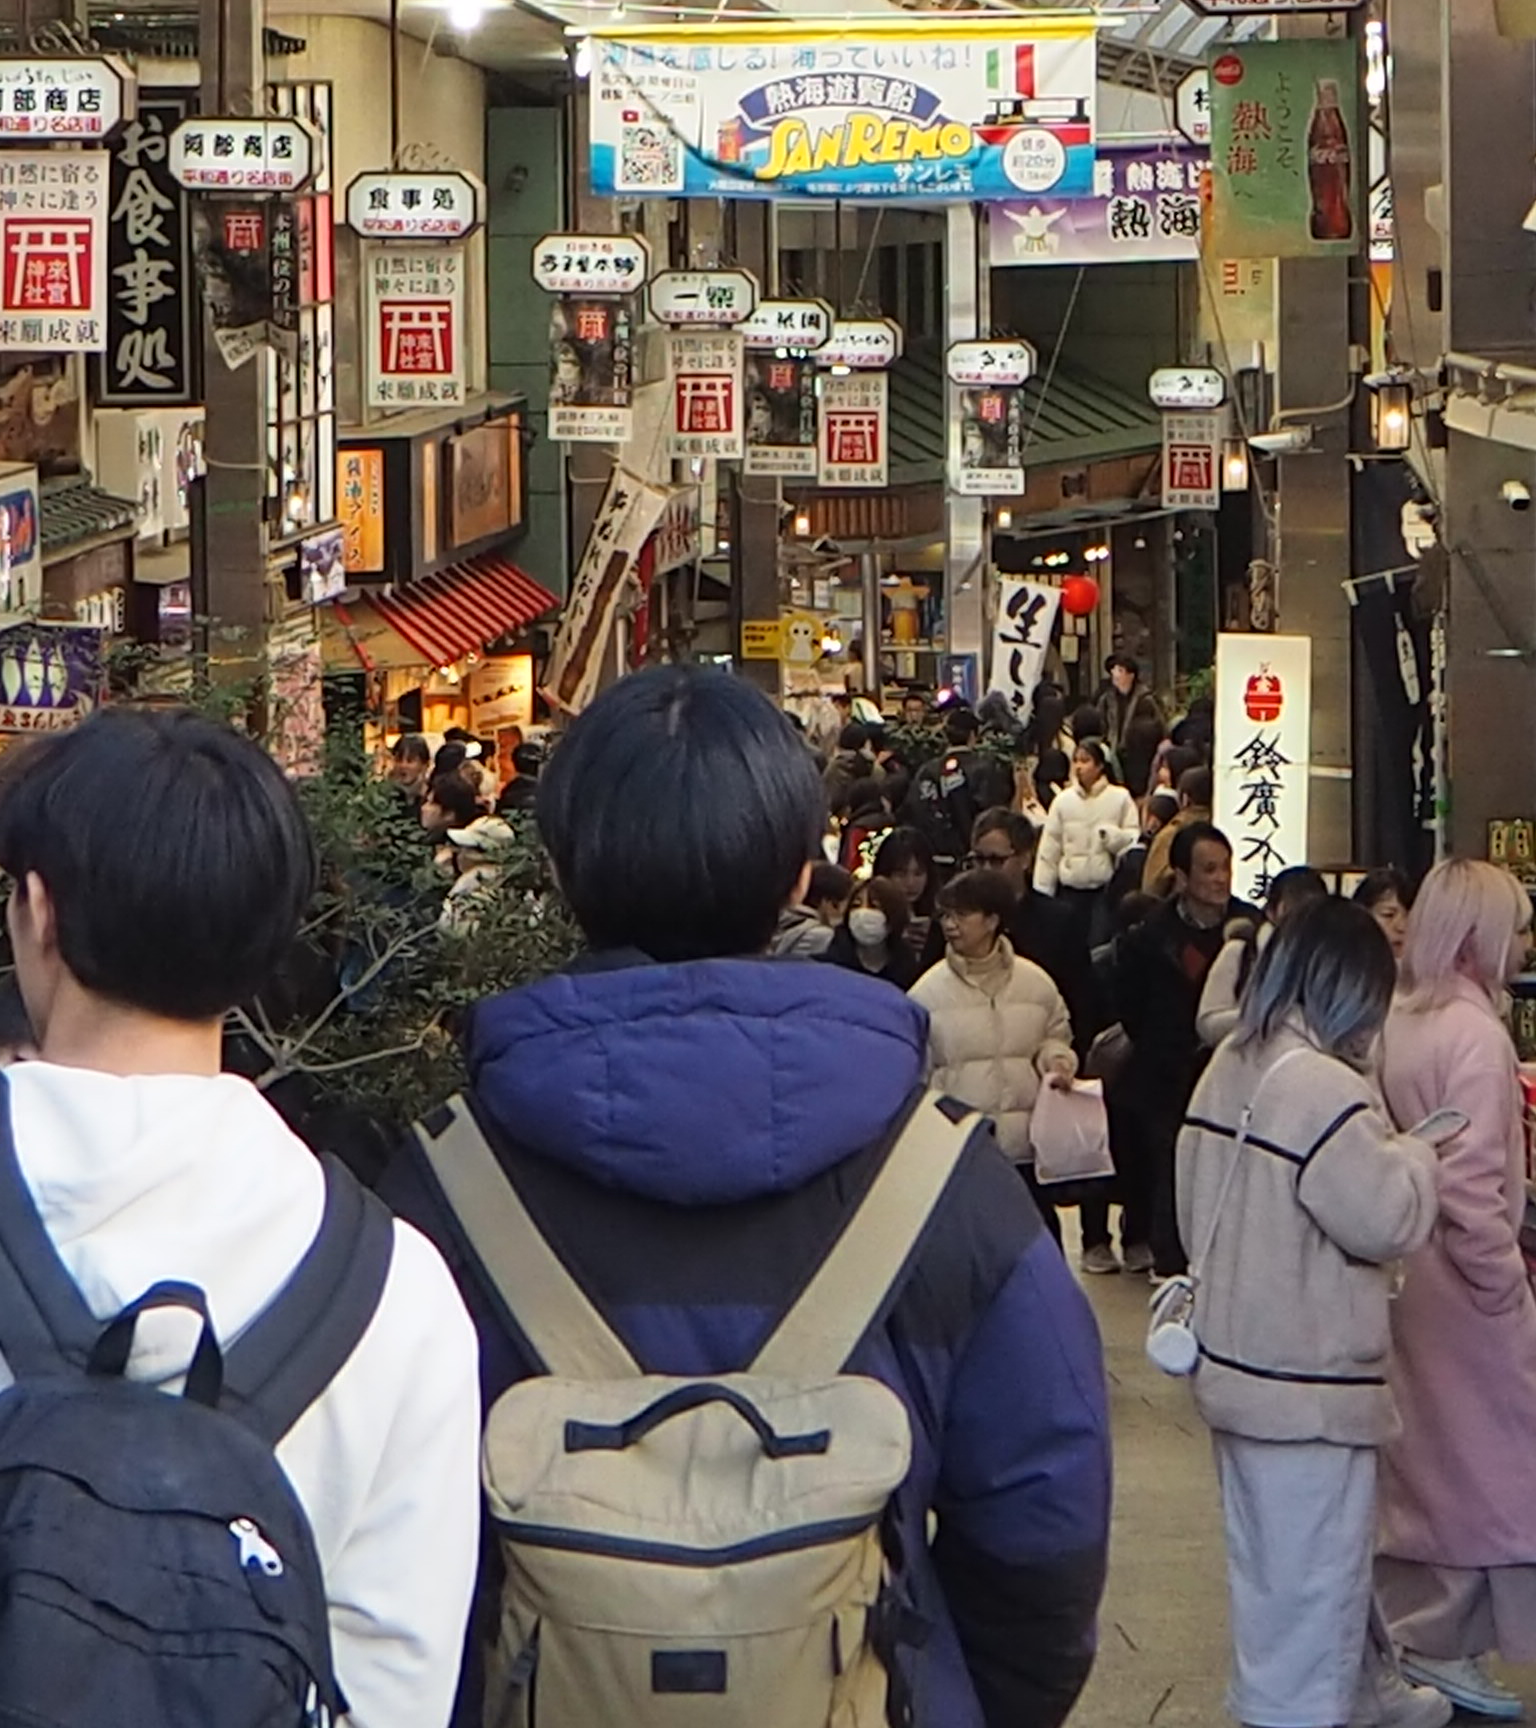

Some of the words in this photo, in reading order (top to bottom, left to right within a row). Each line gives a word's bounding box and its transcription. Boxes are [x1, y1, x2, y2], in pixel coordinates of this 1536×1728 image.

[183, 133, 293, 158] 阿部商店
[183, 169, 293, 185] 平和通り名店街
[893, 164, 972, 182] サンレモ
[367, 187, 456, 211] 食事処
[362, 218, 462, 233] 平和通り名店街
[112, 113, 176, 389] お食事処
